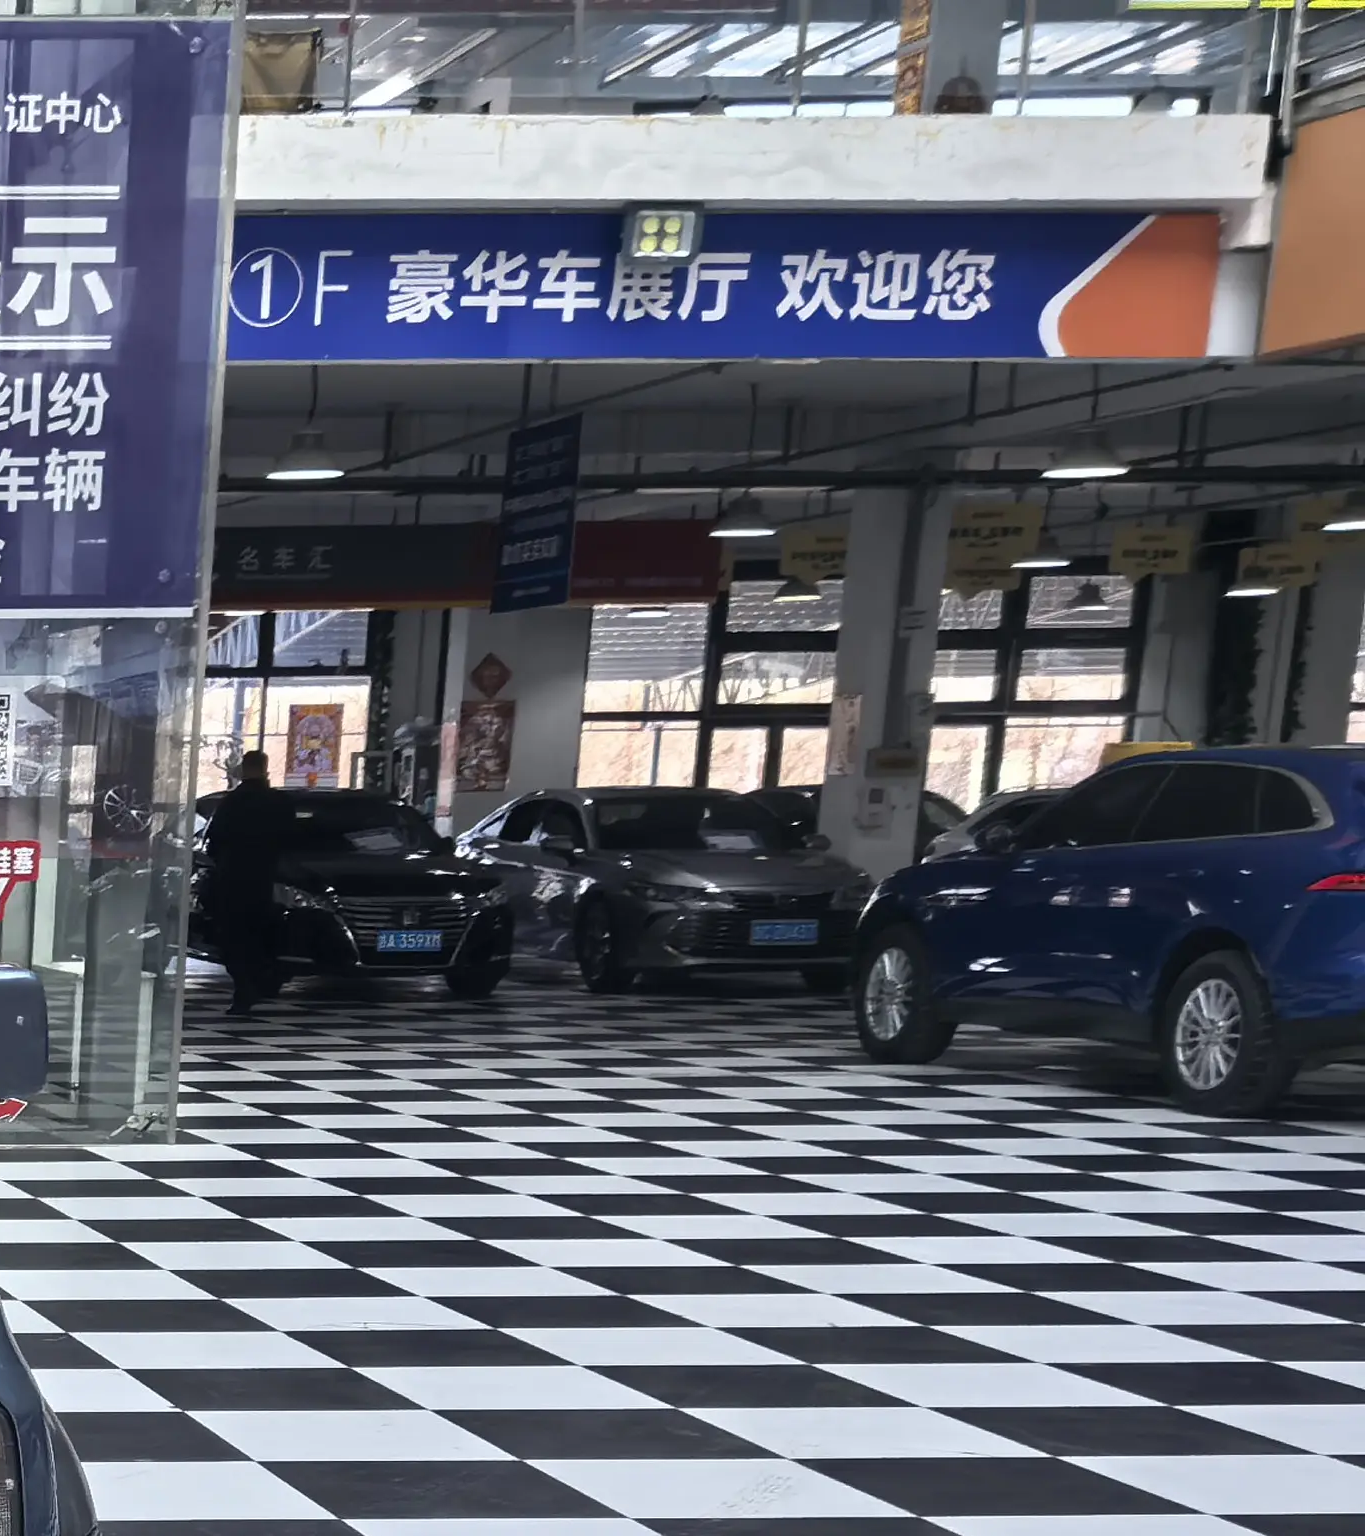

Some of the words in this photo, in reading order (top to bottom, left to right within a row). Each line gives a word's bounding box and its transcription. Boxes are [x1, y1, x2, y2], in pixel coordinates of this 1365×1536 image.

[385, 249, 751, 325] 豪华车展厅
[776, 249, 997, 322] 欢迎您
